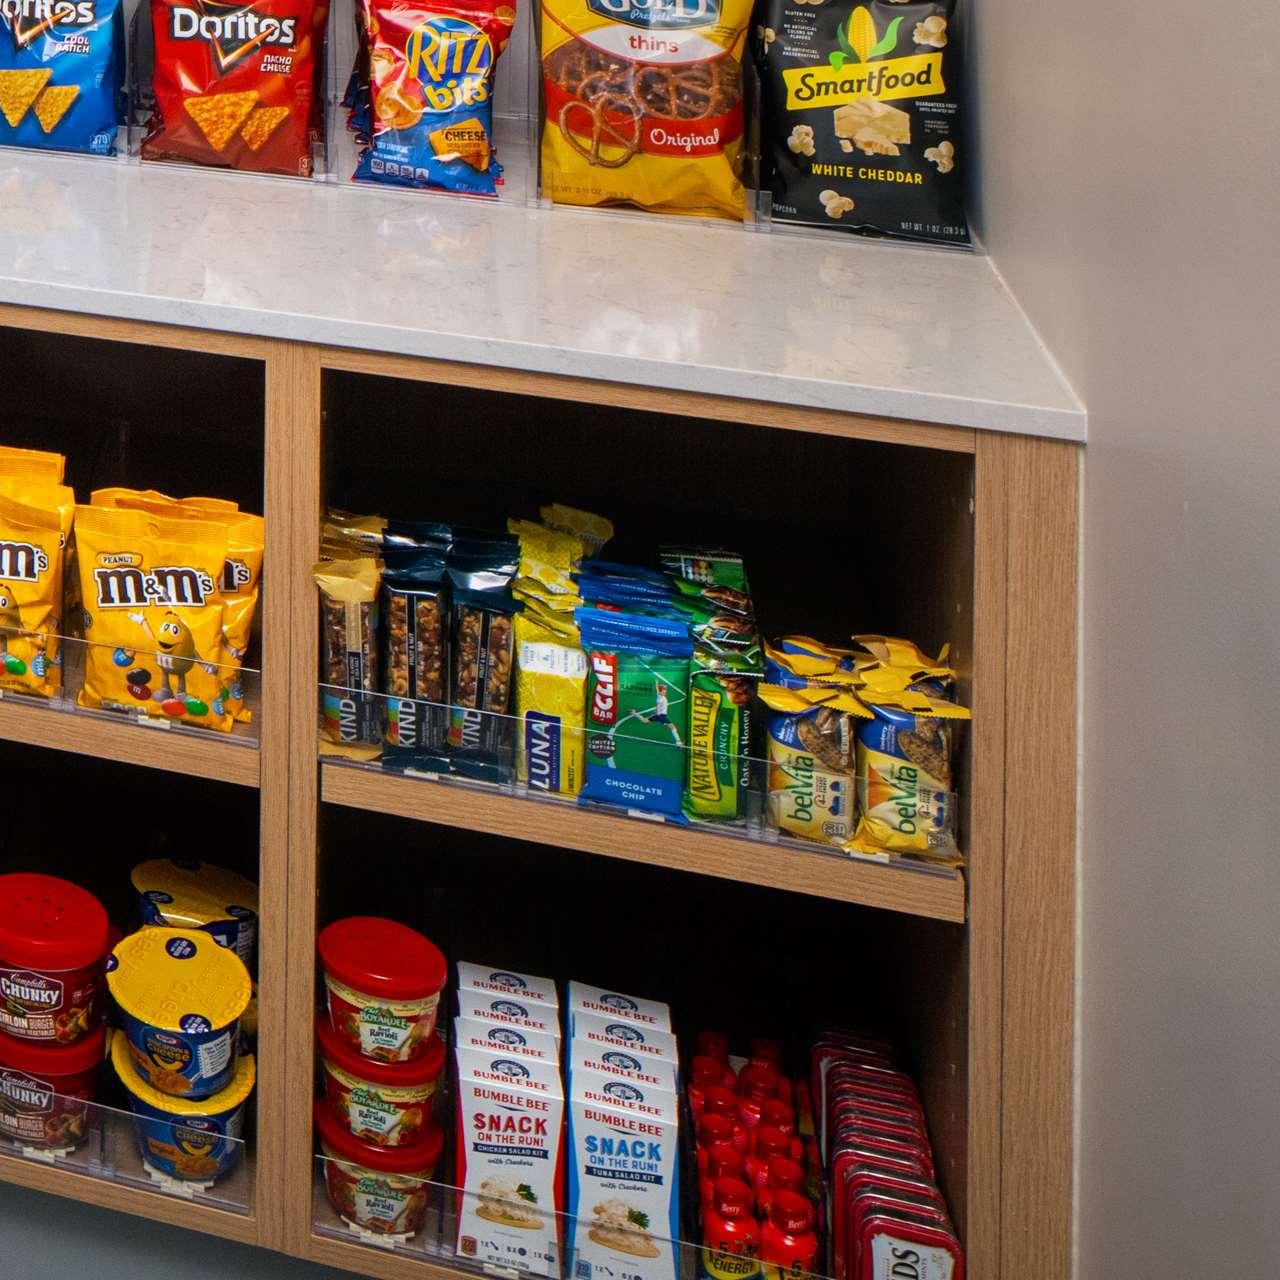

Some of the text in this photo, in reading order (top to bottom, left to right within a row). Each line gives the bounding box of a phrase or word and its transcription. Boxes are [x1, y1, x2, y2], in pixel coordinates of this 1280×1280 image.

[173, 7, 296, 44] Doritos
[63, 34, 89, 46] COOL
[628, 34, 679, 53] thins
[263, 55, 293, 66] NACHO
[408, 26, 492, 82] RITZ
[260, 63, 291, 74] CHEESE
[423, 75, 488, 110] bits
[794, 63, 932, 101] Smartfood
[444, 128, 486, 142] CHEESE
[649, 127, 720, 159] Original
[812, 163, 923, 184] WHITE CHEDDAR
[101, 554, 135, 566] PEANUT
[96, 565, 214, 607] m&m's
[341, 699, 357, 742] KIND
[399, 700, 416, 748] KIND
[531, 722, 550, 789] LUNA
[720, 721, 728, 770] CRUNCHY
[692, 735, 715, 794] NATURE
[605, 778, 662, 796] CHOCOLATE
[622, 792, 645, 800] CHIP
[787, 755, 814, 823] belVita
[892, 765, 918, 835] belVita
[0, 977, 60, 1005] CHUNKY
[473, 1087, 549, 1111] BUMBLE BEE
[473, 1112, 548, 1136] SNACK
[584, 1109, 662, 1136] BUMBLE BEE
[585, 1135, 662, 1161] SNACK
[589, 1155, 658, 1172] ON THE RUN!
[592, 1168, 640, 1181] TUNA SALAD
[720, 1203, 741, 1215] Berry
